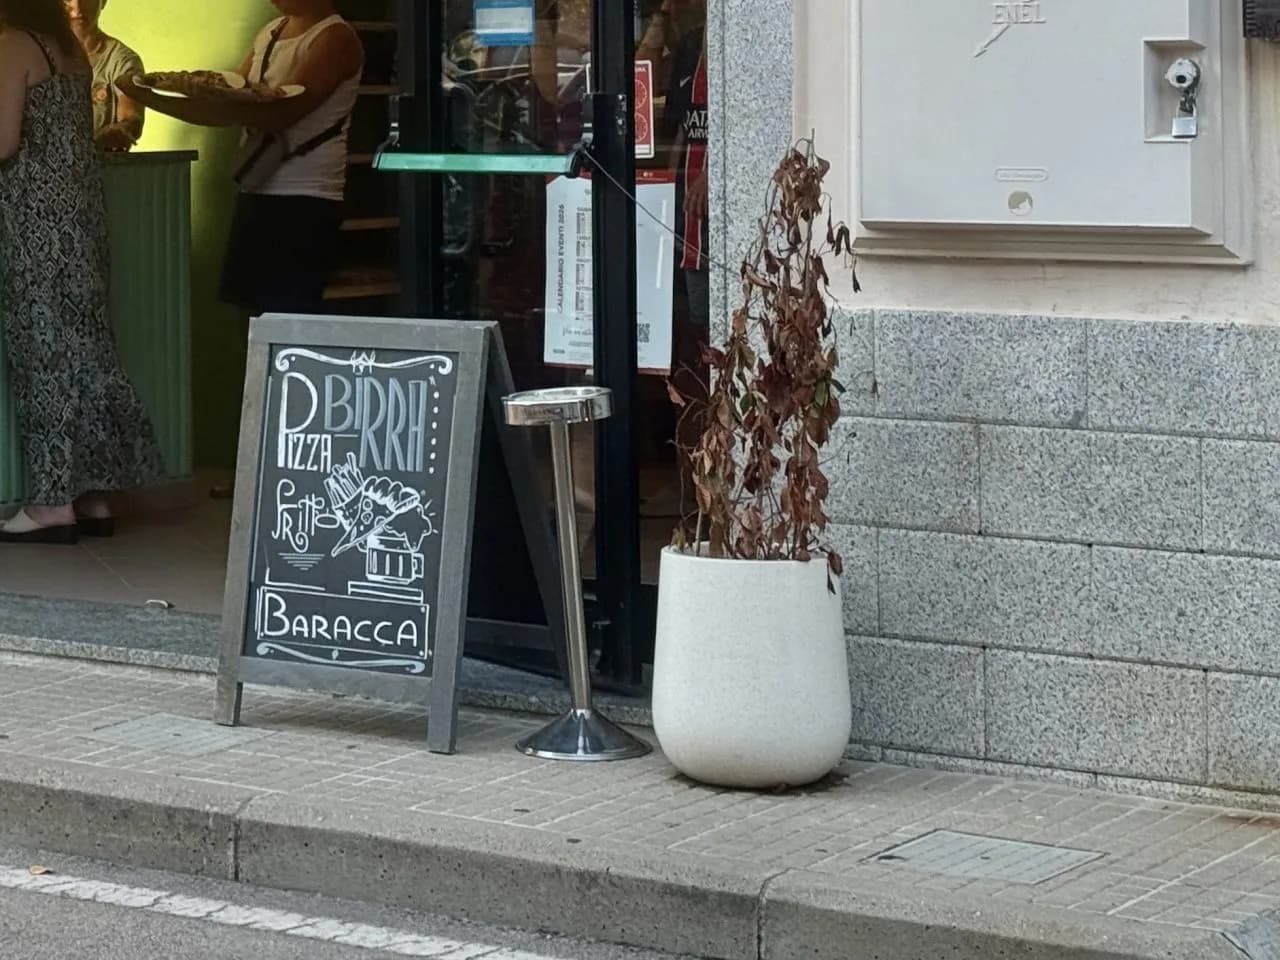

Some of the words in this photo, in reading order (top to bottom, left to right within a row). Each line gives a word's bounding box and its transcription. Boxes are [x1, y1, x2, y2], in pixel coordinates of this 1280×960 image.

[992, 1, 1047, 24] ENEL
[277, 371, 332, 474] PIZZA
[324, 374, 428, 472] BIRRA
[263, 592, 418, 648] BARACCA
